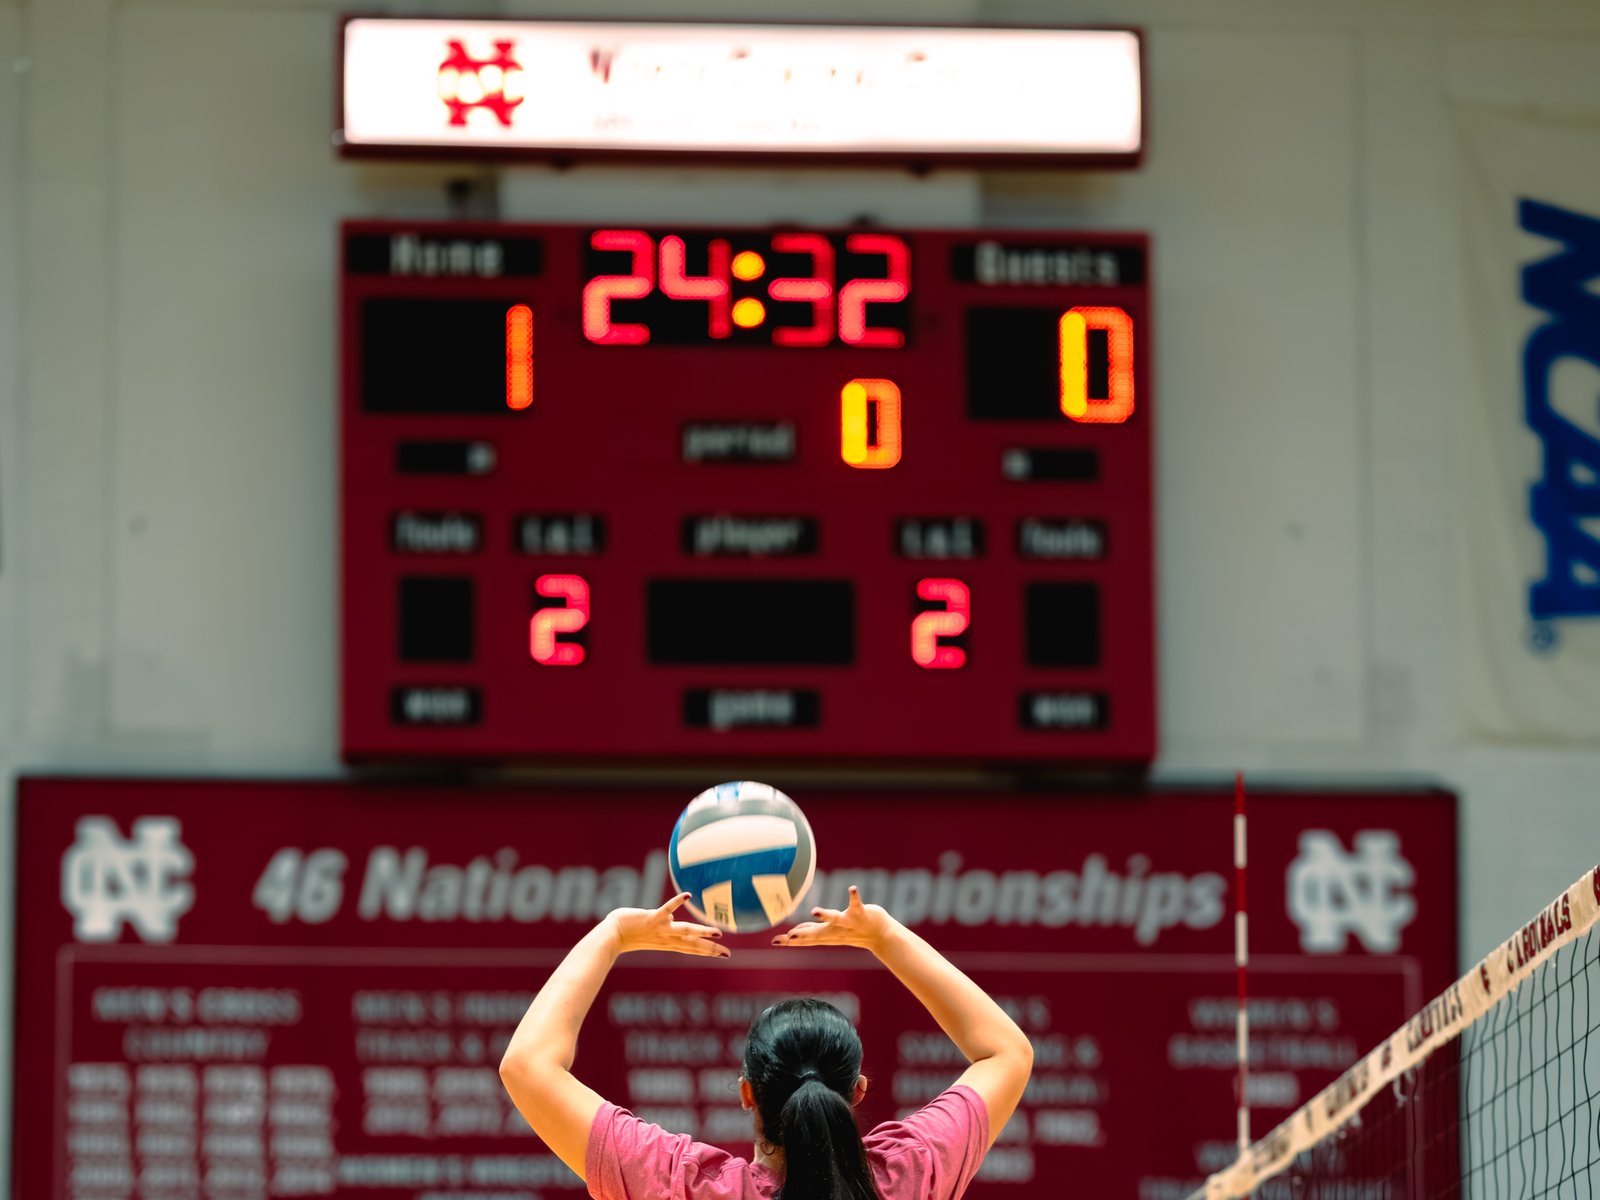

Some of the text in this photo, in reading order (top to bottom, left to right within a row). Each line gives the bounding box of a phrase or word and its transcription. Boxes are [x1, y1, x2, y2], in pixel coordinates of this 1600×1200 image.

[583, 230, 911, 347] 24:32
[506, 304, 533, 411] 1
[1059, 306, 1134, 423] 0
[841, 378, 901, 469] 0
[530, 574, 590, 666] 2
[911, 578, 970, 669] 2
[252, 847, 347, 925] 46
[357, 846, 667, 923] National
